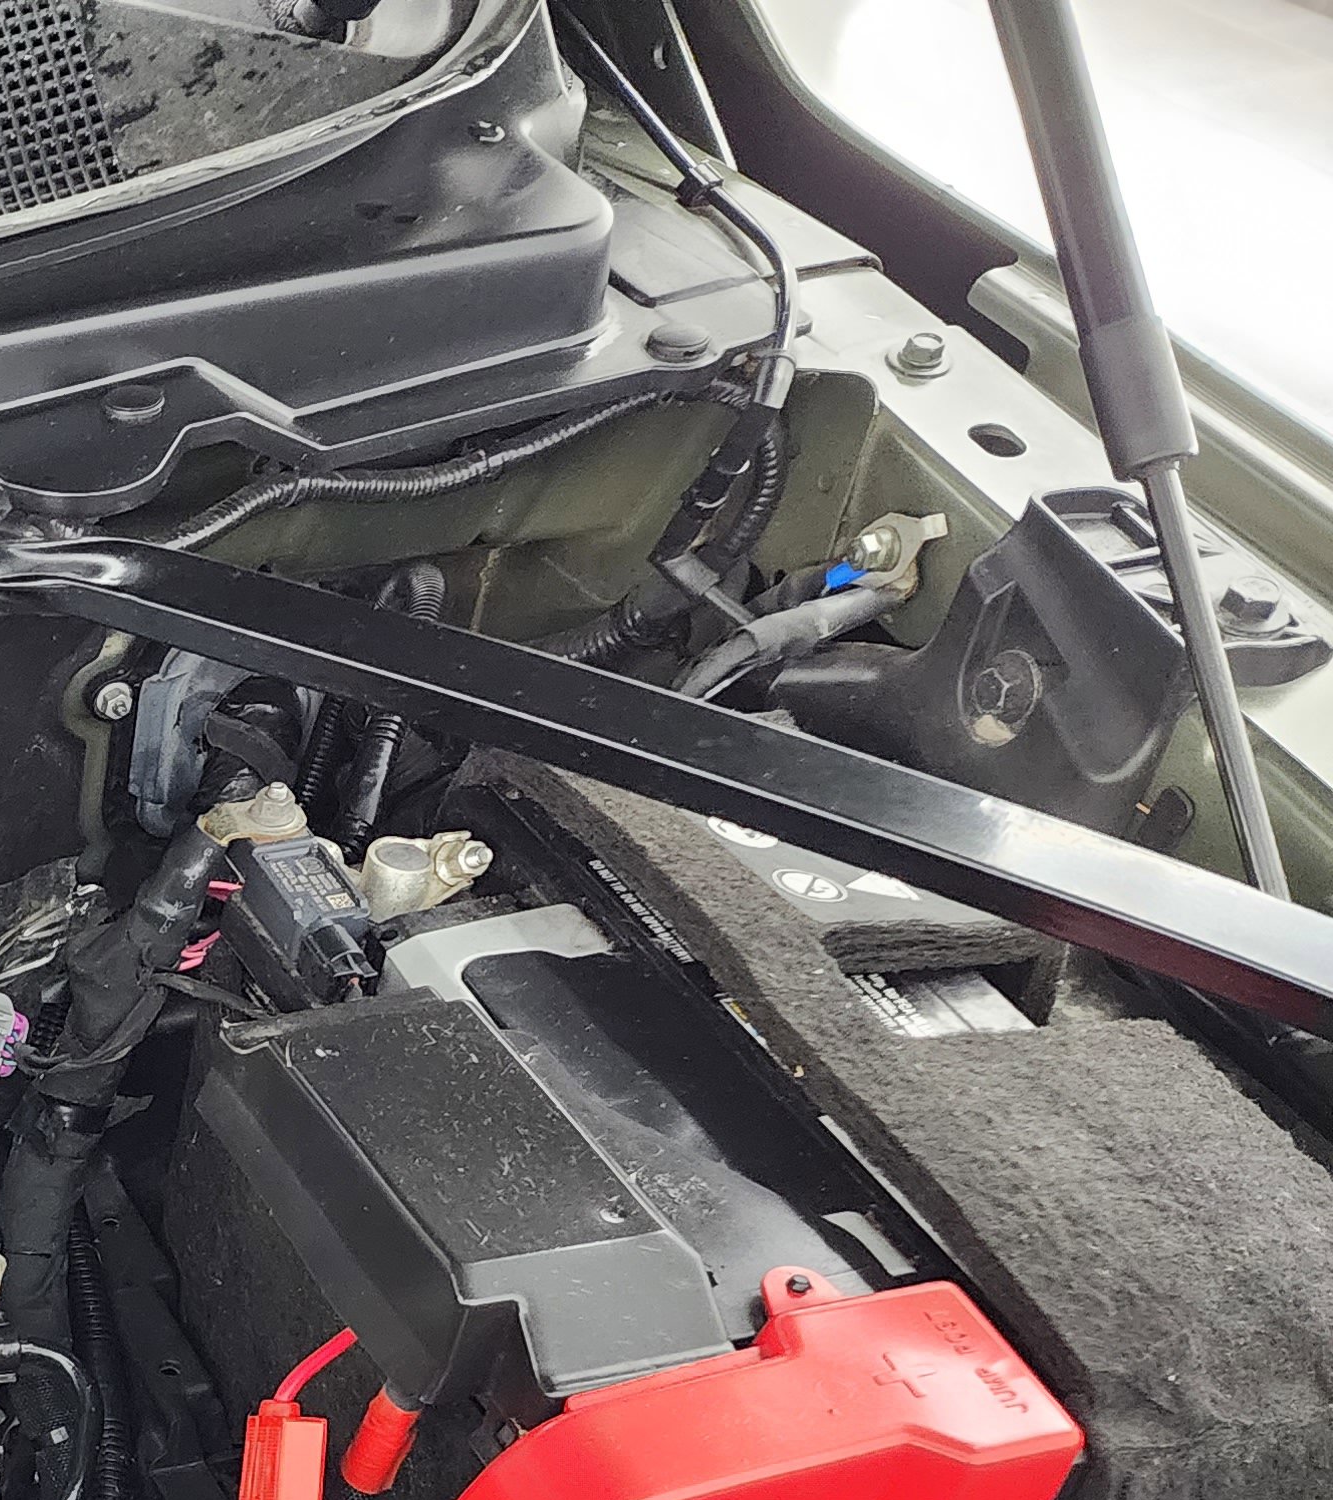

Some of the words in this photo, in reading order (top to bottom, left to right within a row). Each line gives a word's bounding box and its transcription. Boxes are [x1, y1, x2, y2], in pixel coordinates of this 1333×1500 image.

[588, 859, 606, 870] DO
[597, 868, 619, 882] NOT
[620, 893, 638, 904] DO
[628, 902, 651, 917] NOT
[641, 915, 667, 935] OPEN
[923, 1310, 981, 1356] POST
[974, 1367, 1029, 1414] JUMP
